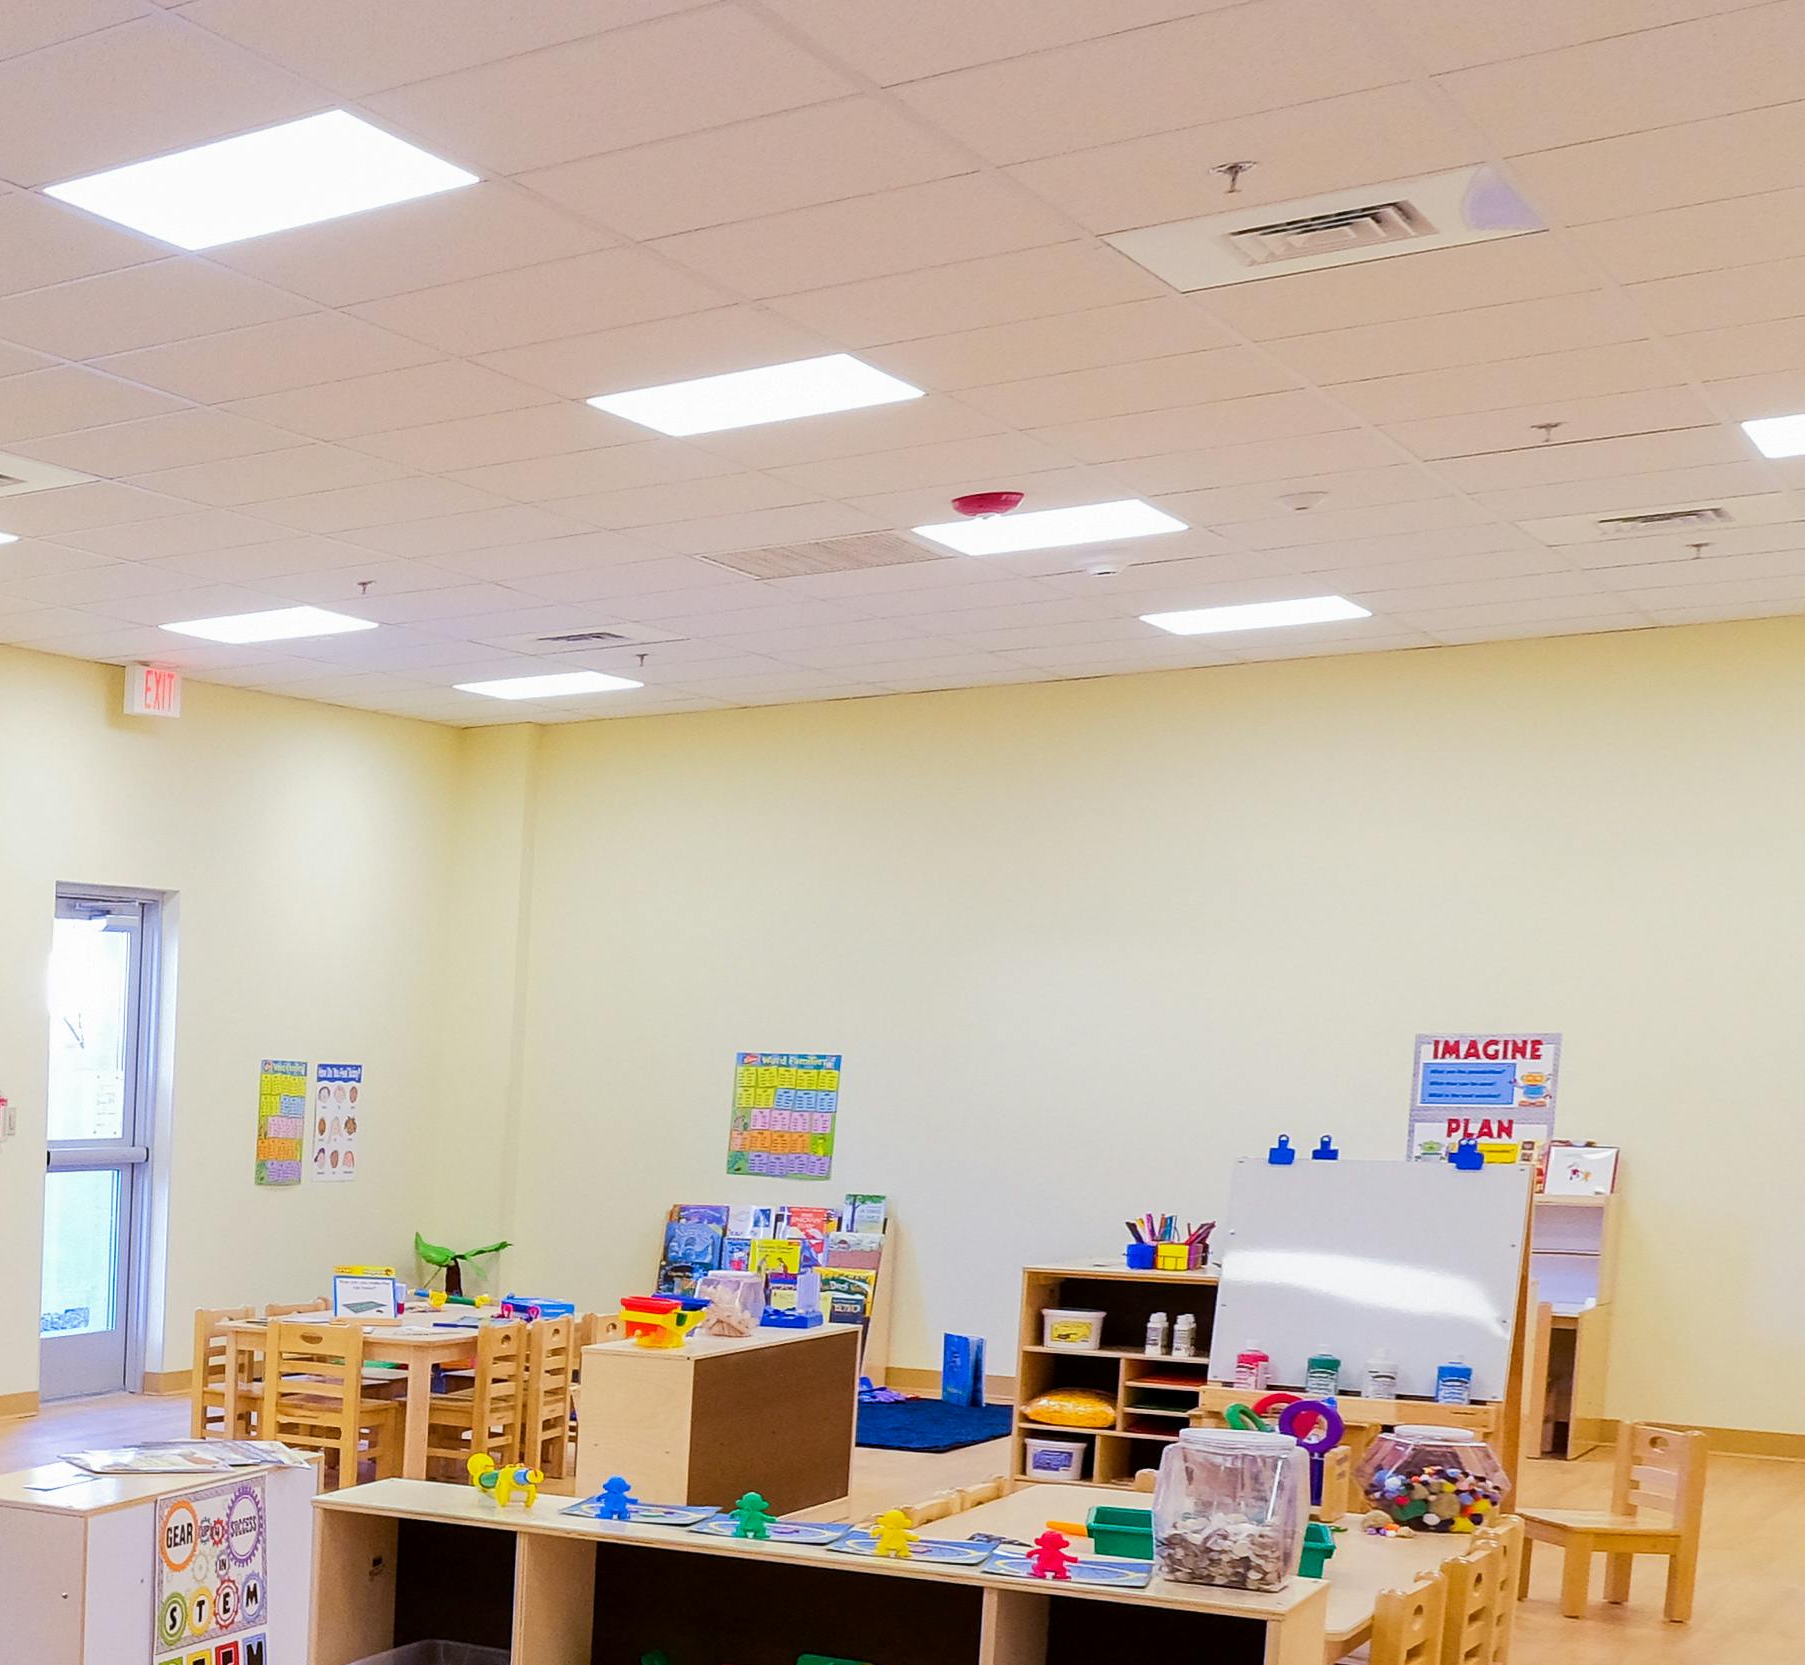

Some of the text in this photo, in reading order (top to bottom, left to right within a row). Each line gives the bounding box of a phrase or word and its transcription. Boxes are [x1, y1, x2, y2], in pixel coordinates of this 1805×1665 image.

[144, 669, 176, 713] EXIT
[1432, 1039, 1544, 1060] IMAGINE
[1446, 1118, 1515, 1140] PLAN
[166, 1522, 193, 1549] GEAR
[231, 1515, 257, 1538] SUCCESS
[218, 1559, 227, 1571] IN
